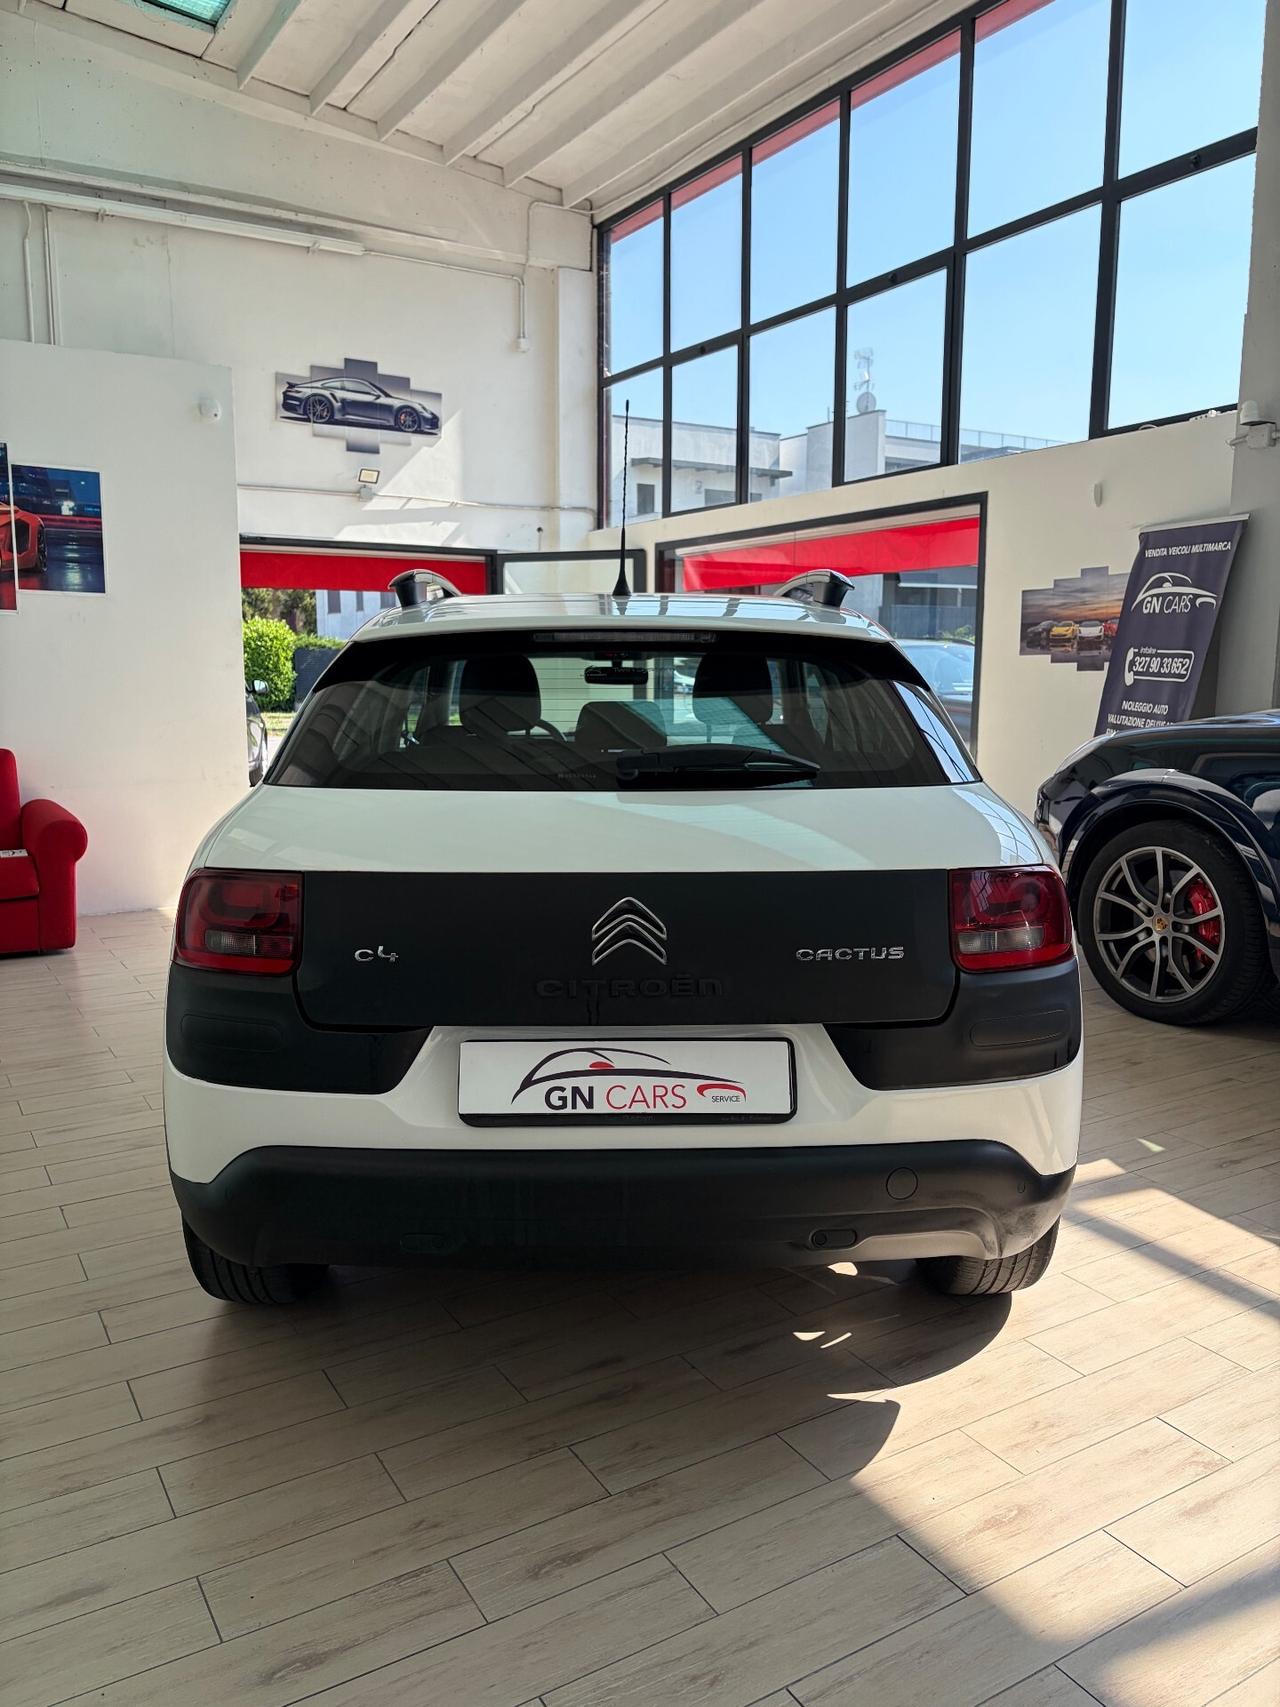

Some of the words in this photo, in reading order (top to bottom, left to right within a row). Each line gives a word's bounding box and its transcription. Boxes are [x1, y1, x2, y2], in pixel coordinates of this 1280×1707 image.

[1145, 547, 1168, 558] VENDITA
[1168, 545, 1191, 556] VEICOLI
[1191, 541, 1231, 553] MULTIMARCA
[1142, 596, 1162, 614] GN
[1163, 594, 1193, 614] CARS
[1133, 656, 1151, 672] 327
[1149, 657, 1161, 673] 90
[1121, 700, 1153, 713] NOLEGGIO
[1152, 704, 1169, 715] AUTO
[1107, 713, 1145, 728] VALUTAZIONE
[354, 945, 399, 962] C4
[796, 946, 905, 961] CACTUS
[544, 1085, 595, 1111] GN
[605, 1084, 687, 1110] CARS
[711, 1094, 741, 1104] SERVICE
